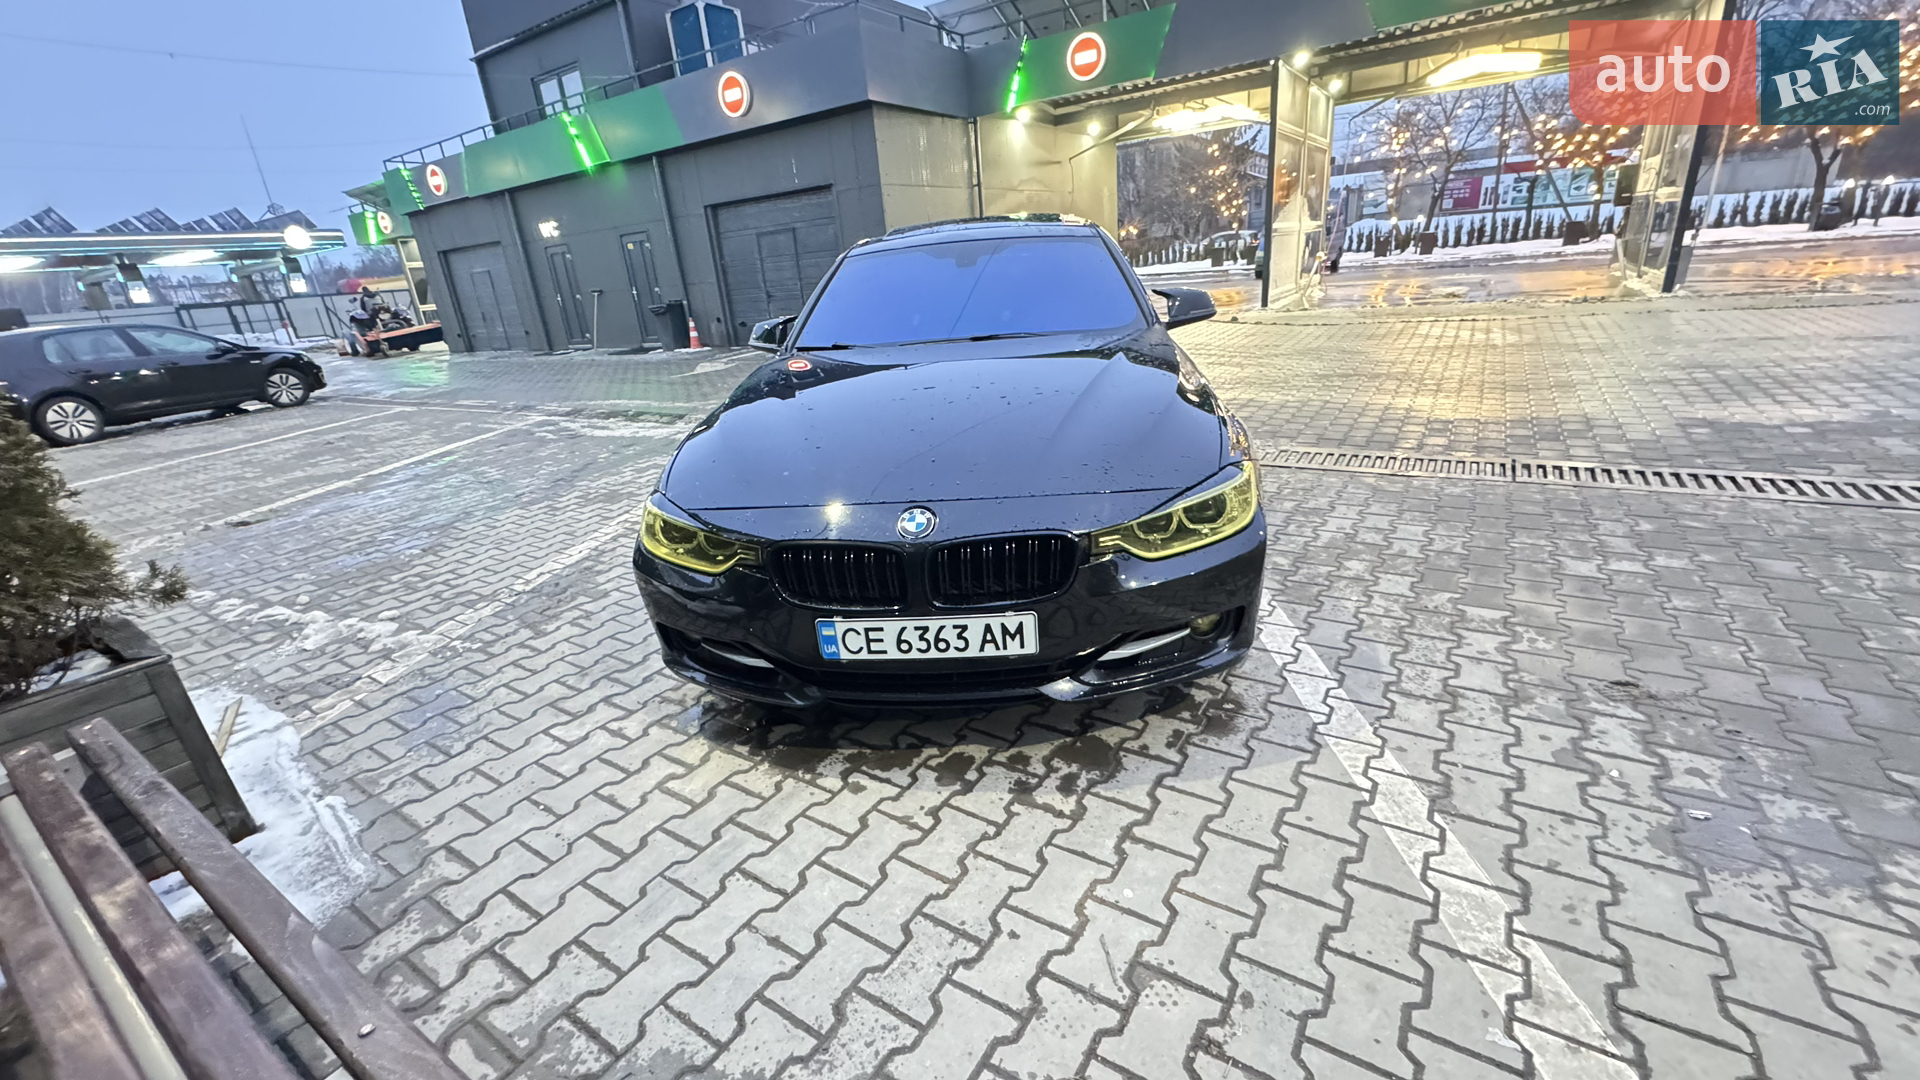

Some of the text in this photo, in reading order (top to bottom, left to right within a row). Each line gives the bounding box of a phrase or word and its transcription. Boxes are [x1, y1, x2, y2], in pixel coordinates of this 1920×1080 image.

[824, 644, 838, 653] UA
[841, 621, 1026, 655] CE 6363 AM
